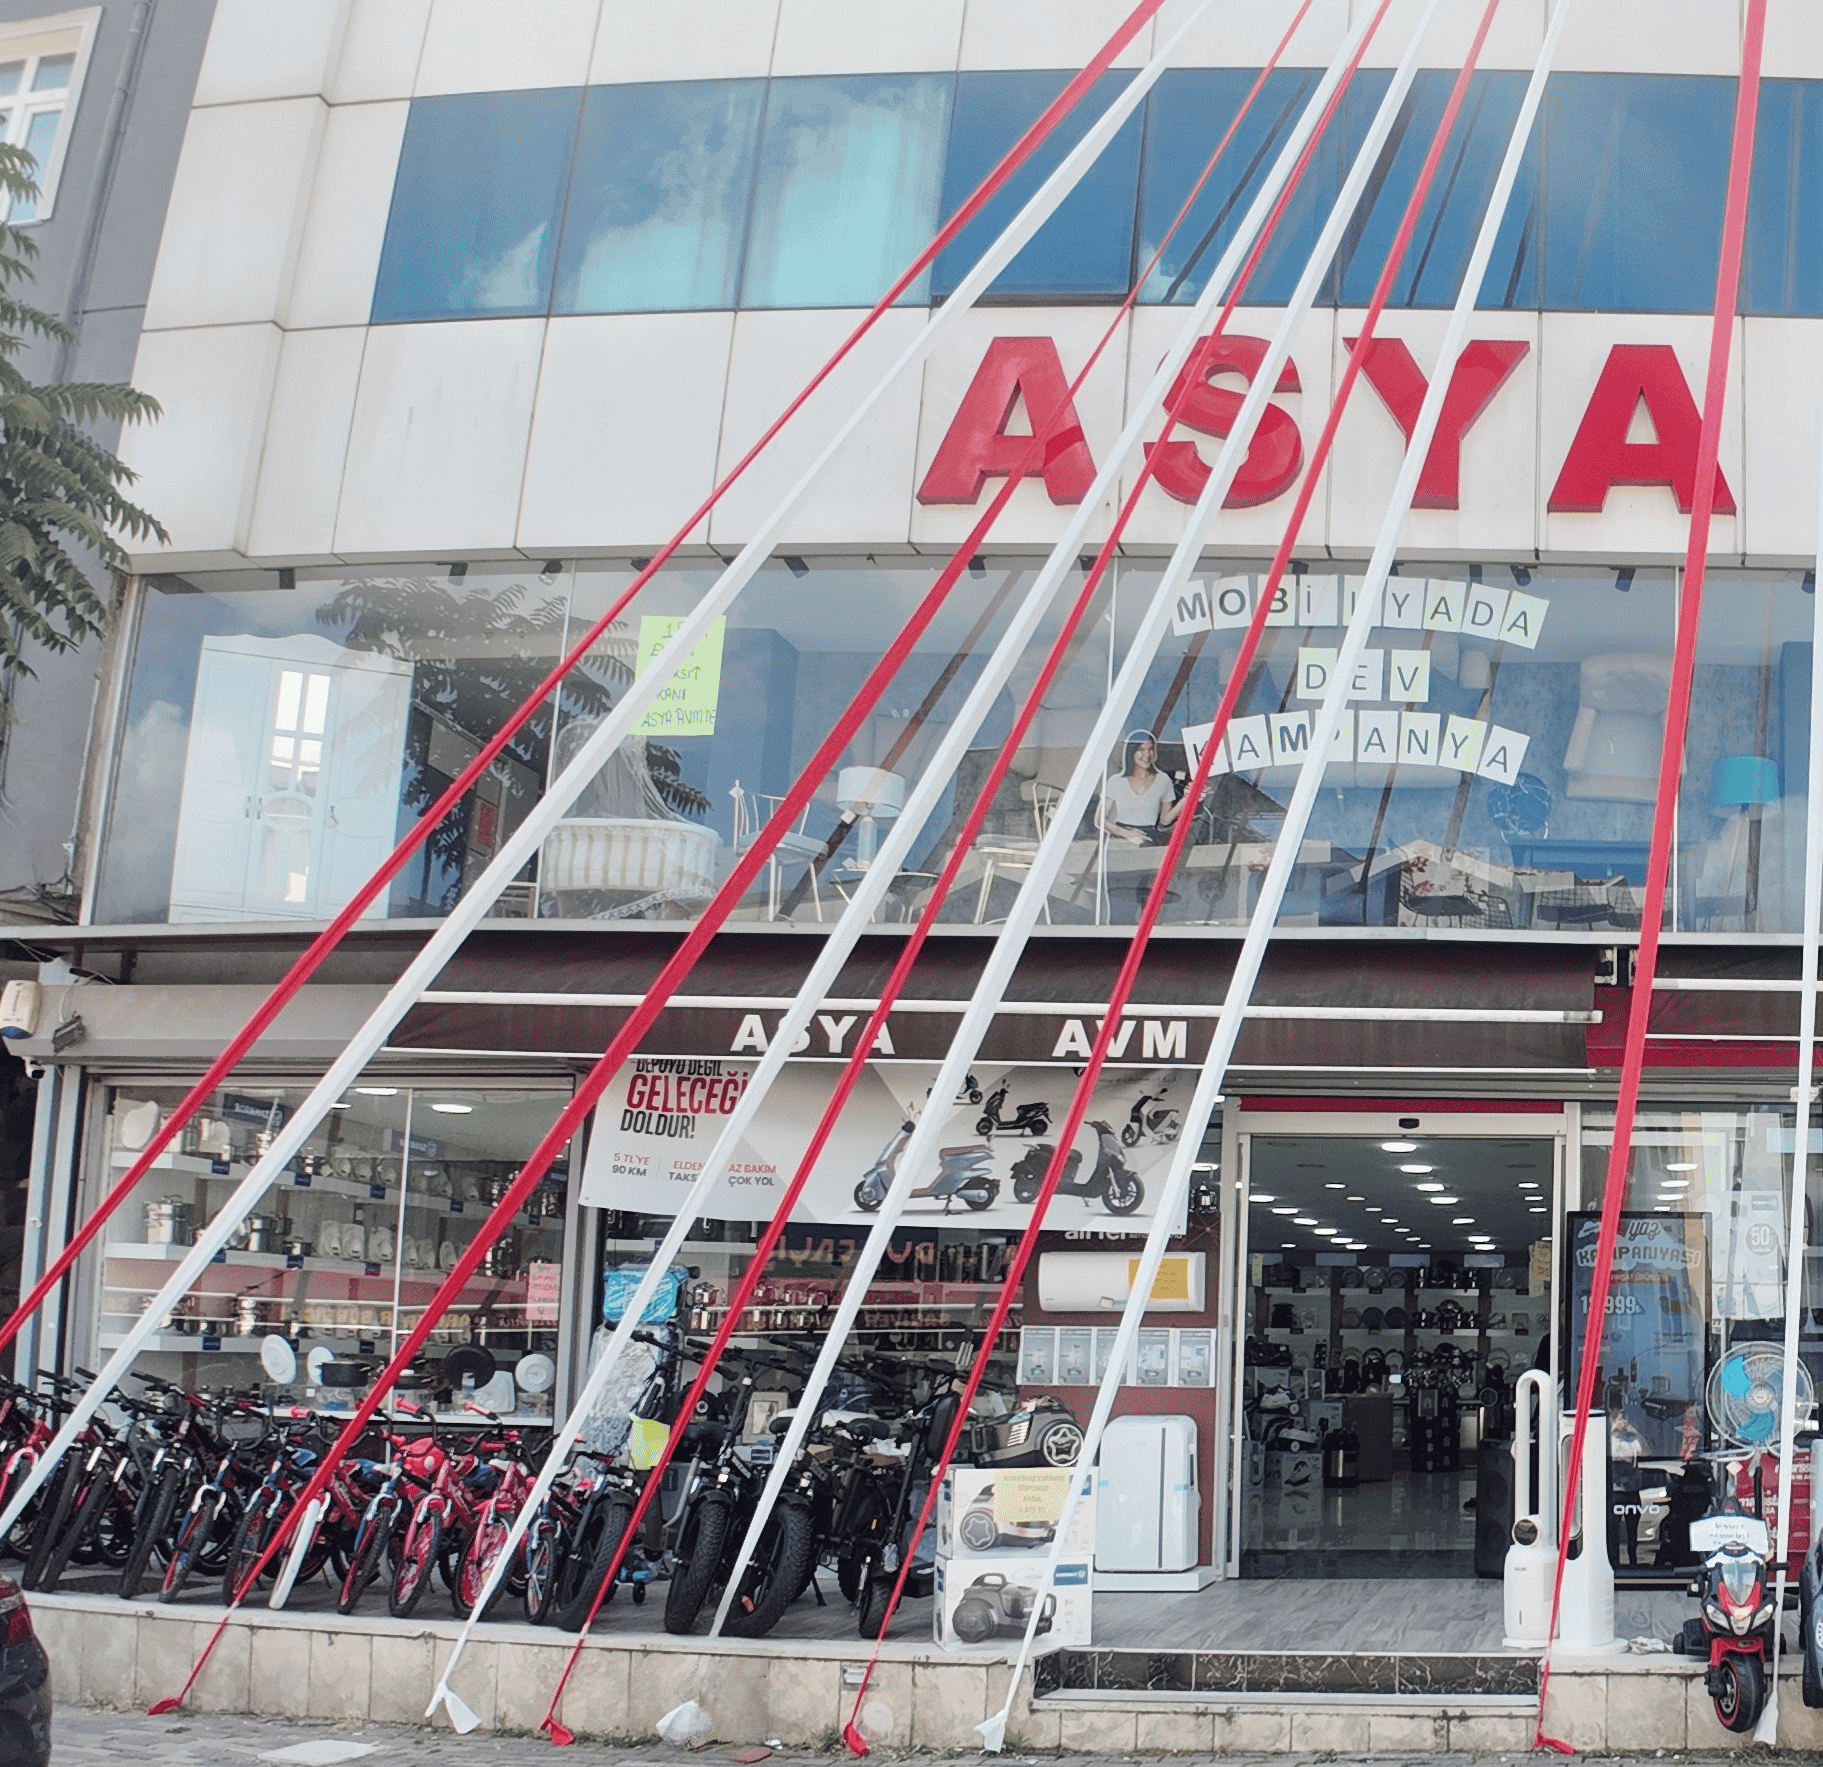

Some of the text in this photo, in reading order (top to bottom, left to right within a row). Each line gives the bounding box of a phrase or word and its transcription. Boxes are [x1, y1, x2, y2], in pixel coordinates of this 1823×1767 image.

[917, 334, 1738, 516] ASYA
[1305, 663, 1419, 692] DEV
[1192, 722, 1509, 774] KAMANYA
[1051, 1019, 1188, 1059] AVM
[620, 1109, 696, 1139] DOLDUR!
[628, 1167, 647, 1177] KM
[668, 1171, 700, 1183] TAKS
[728, 1164, 742, 1173] AZ
[755, 1176, 775, 1187] YOL
[1613, 1503, 1661, 1516] onvo
